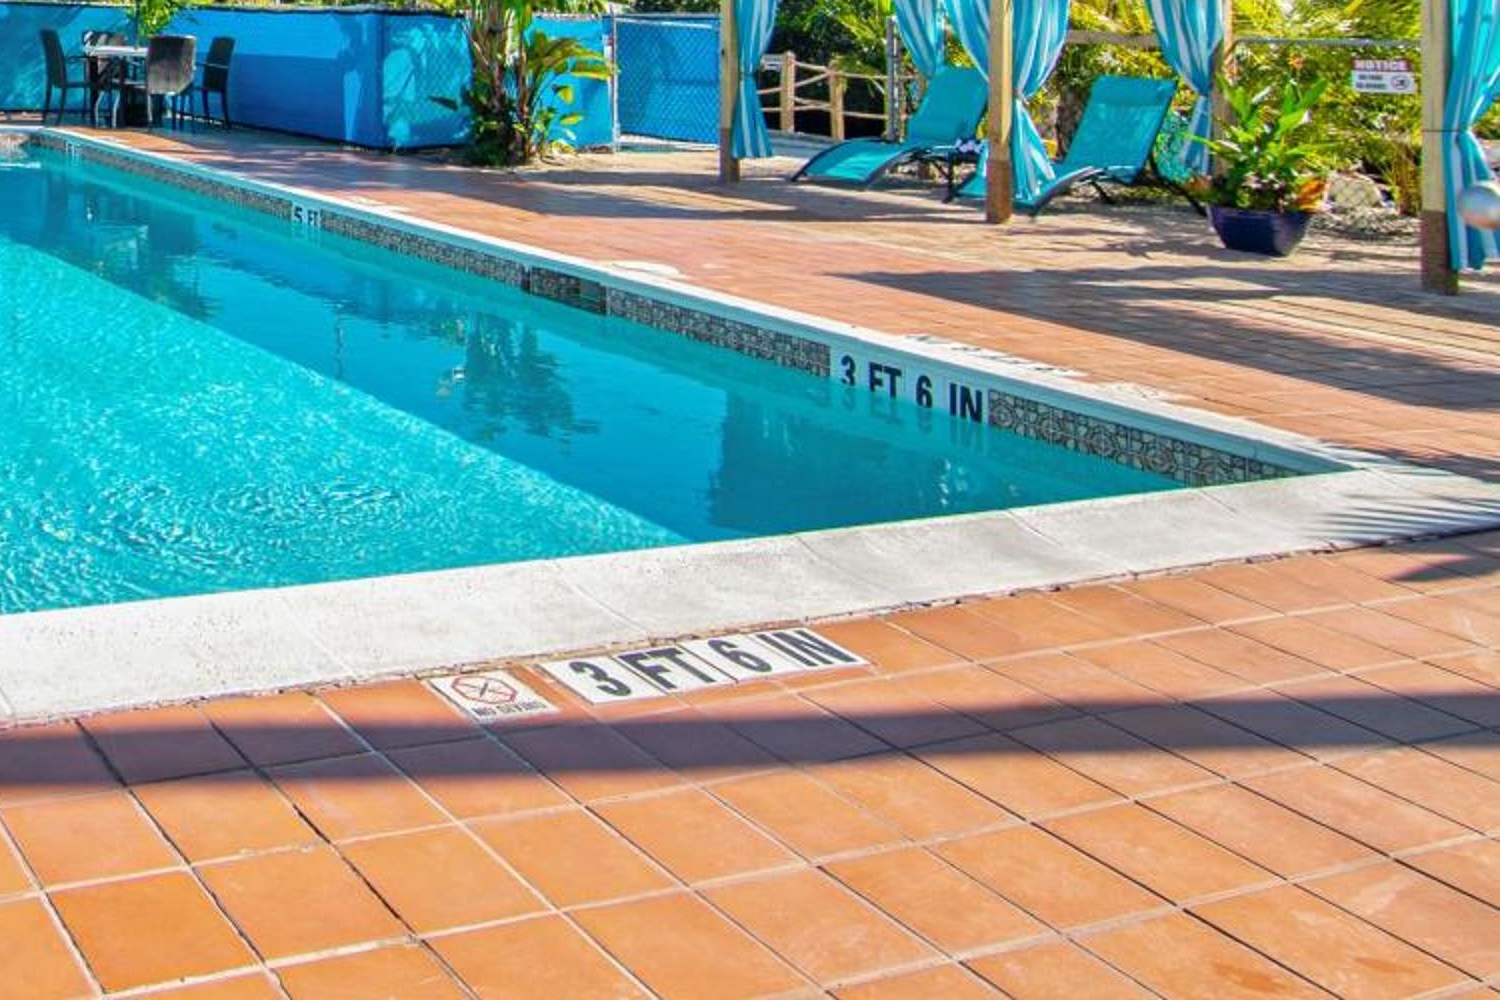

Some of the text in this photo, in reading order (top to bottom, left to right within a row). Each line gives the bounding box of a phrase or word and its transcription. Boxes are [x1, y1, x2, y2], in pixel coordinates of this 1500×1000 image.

[293, 206, 318, 226] 5 FT
[840, 354, 983, 424] 3 FT 6 IN
[569, 630, 858, 696] 3 FT 6 IN
